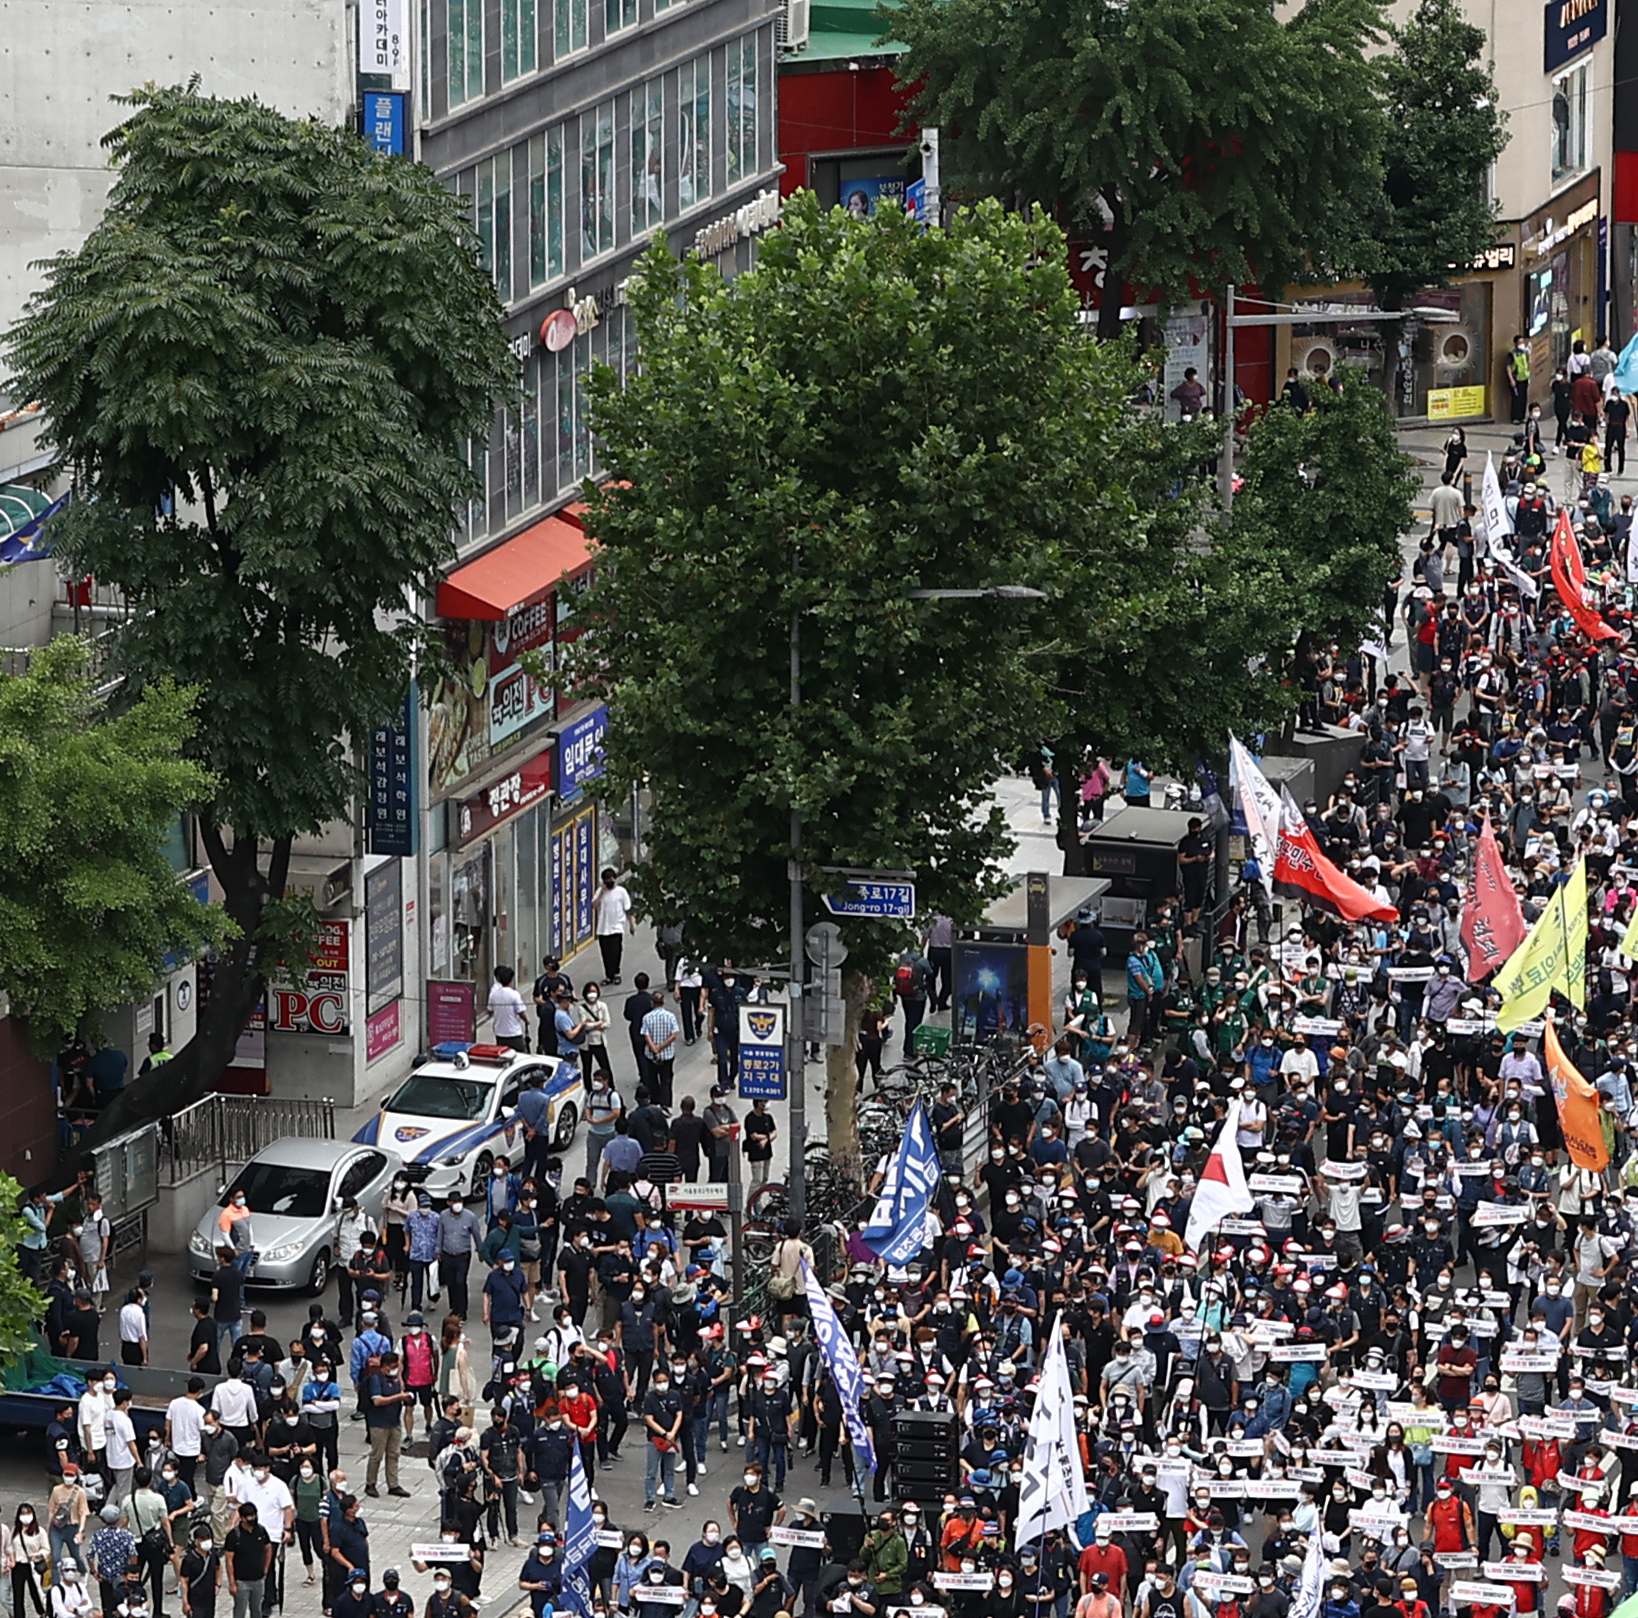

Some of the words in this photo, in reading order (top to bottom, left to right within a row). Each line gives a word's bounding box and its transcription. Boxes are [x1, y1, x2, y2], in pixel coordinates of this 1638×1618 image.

[512, 602, 547, 641] COFFEE
[488, 772, 521, 818] 정관장
[857, 885, 910, 903] 종로17길
[843, 902, 881, 914] Jong-ro
[883, 903, 910, 915] 17-gil
[316, 959, 339, 968] OUT
[273, 991, 344, 1034] PC
[743, 1060, 780, 1072] 종로2가
[743, 1071, 780, 1083] 지구대
